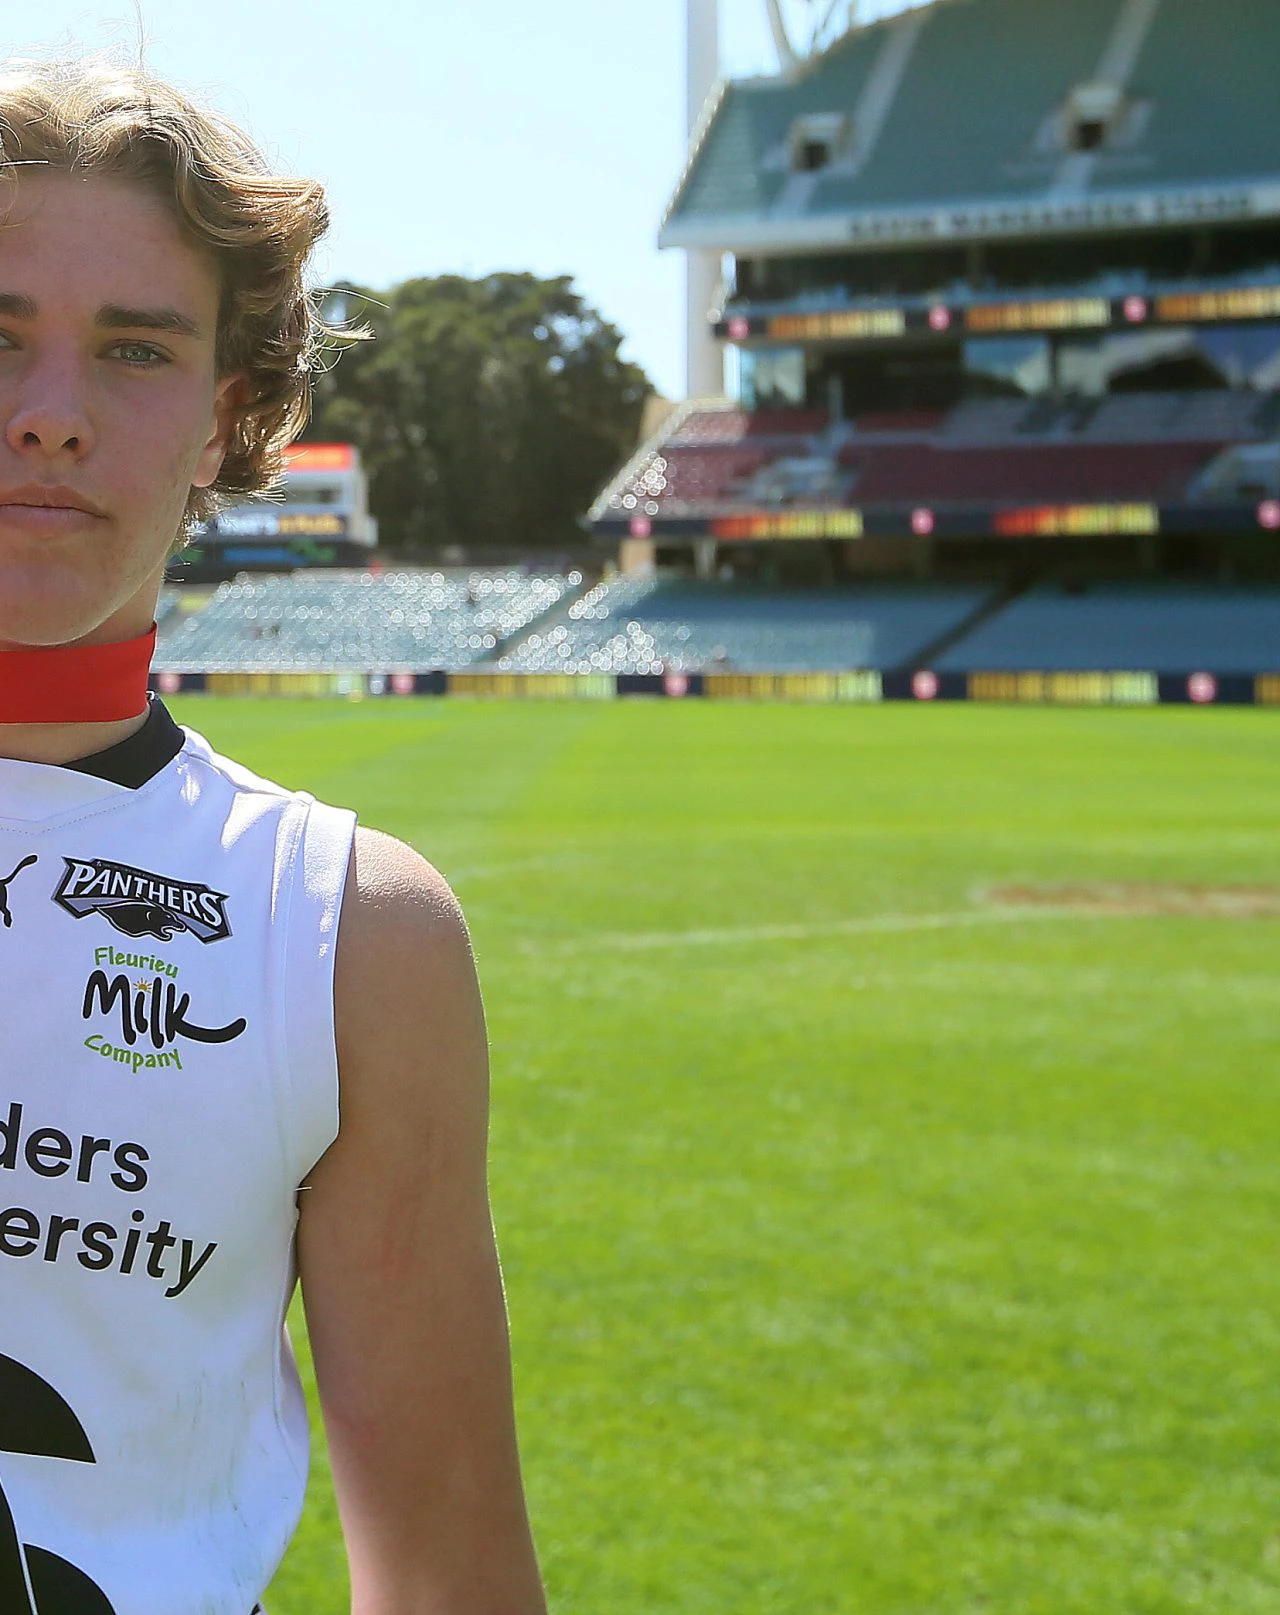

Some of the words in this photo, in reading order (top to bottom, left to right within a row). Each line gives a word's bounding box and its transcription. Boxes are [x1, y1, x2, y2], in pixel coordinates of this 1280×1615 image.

[61, 862, 222, 927] PANTHERS
[94, 946, 179, 978] Fleurieu
[83, 970, 247, 1049] Milk
[84, 1034, 183, 1074] Company
